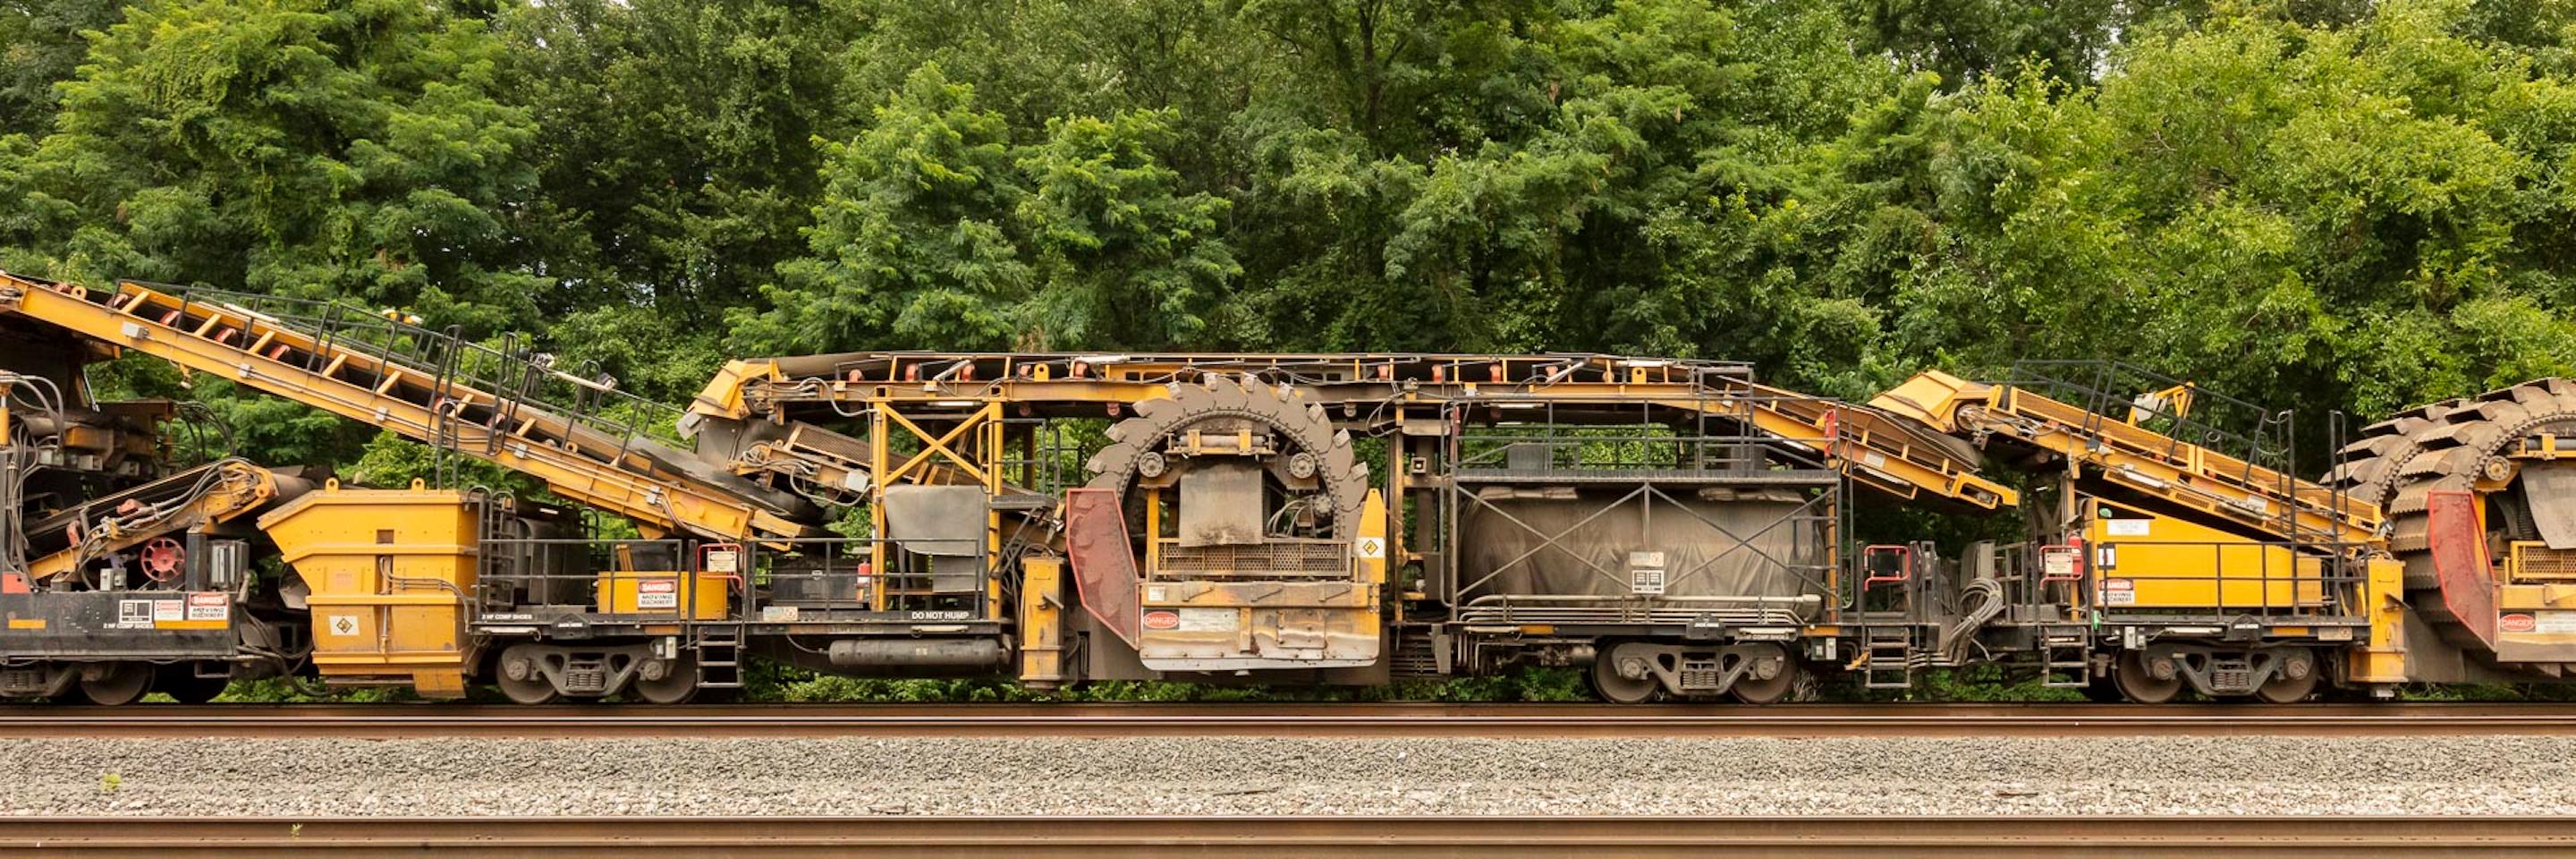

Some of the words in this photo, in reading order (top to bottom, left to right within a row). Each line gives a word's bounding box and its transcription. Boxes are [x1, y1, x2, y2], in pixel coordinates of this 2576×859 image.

[641, 583, 673, 591] DANGER
[912, 611, 925, 619] DO
[926, 611, 944, 619] NOT
[945, 611, 970, 619] HUMP
[1146, 616, 1177, 625] DANGER
[2502, 618, 2535, 627] DANGER
